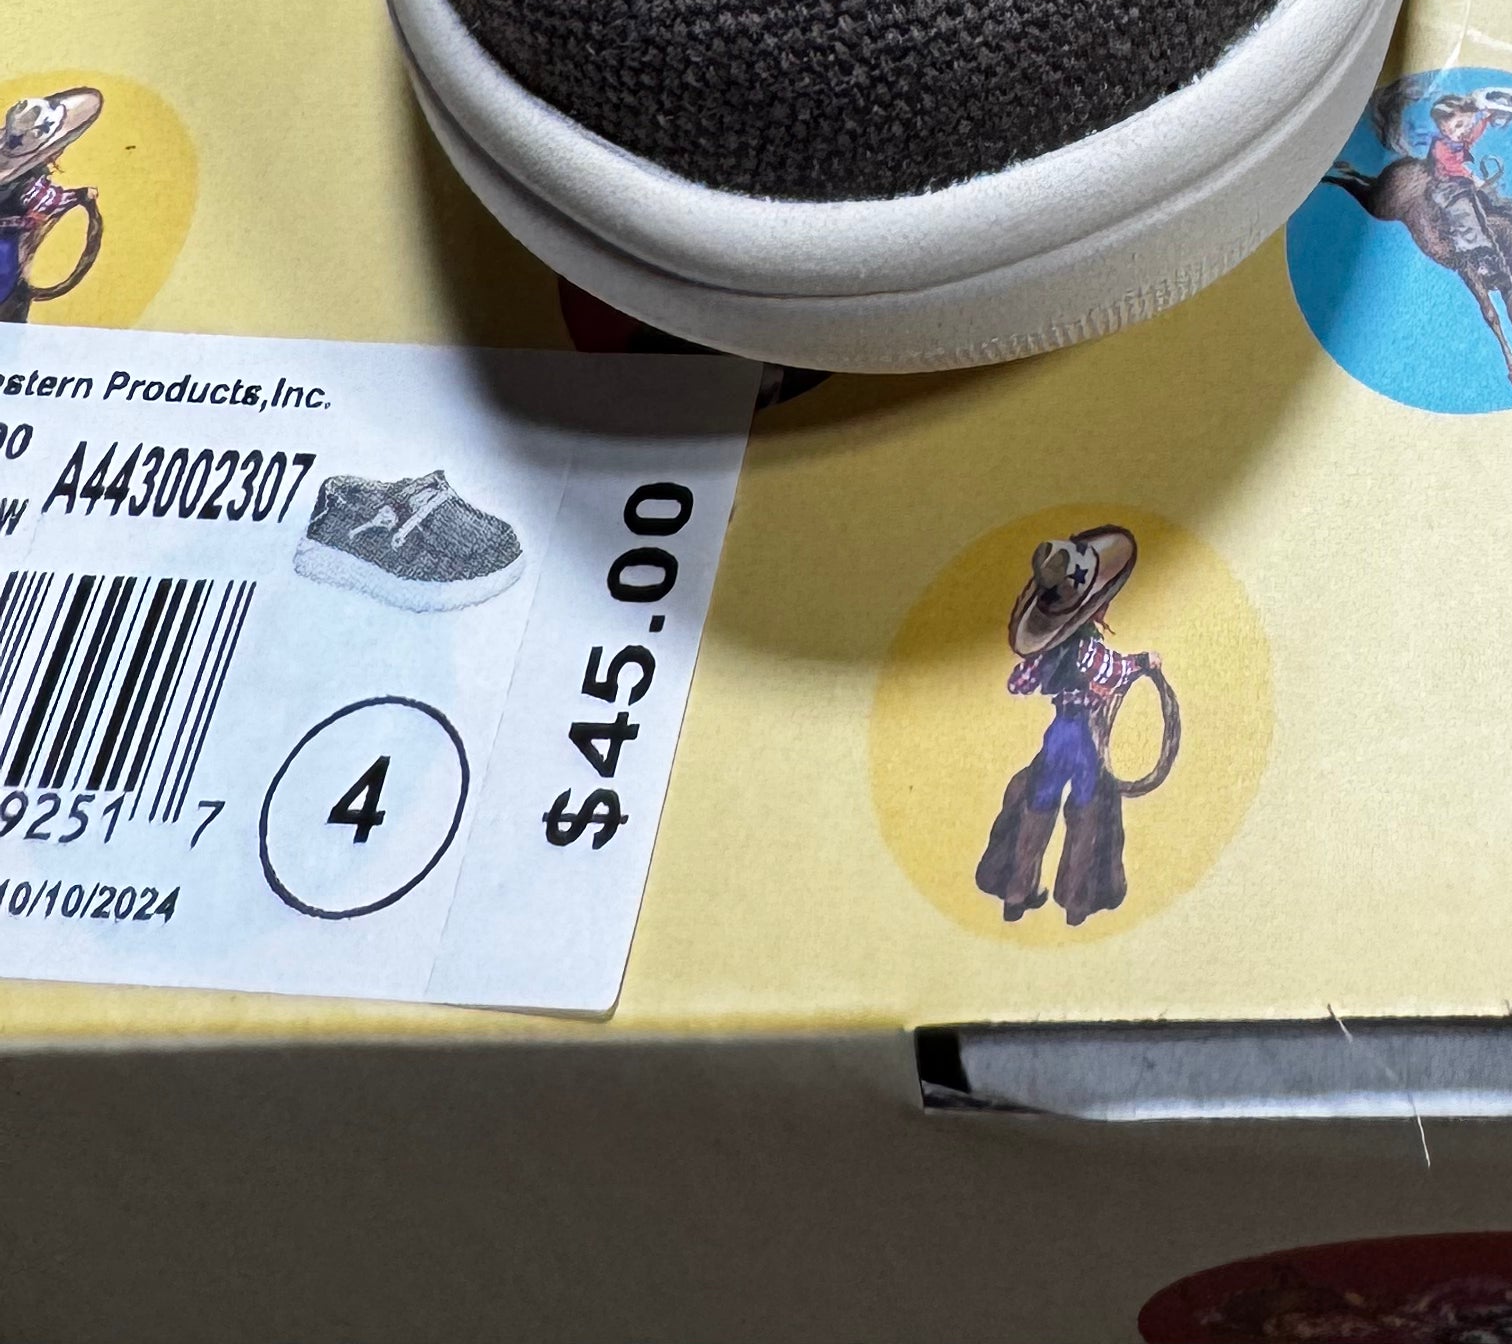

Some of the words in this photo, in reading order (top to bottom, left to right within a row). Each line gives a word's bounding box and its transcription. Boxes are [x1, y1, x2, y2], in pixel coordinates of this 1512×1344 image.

[103, 370, 331, 412] Products,Inc.
[41, 441, 317, 523] A443002307
[542, 482, 694, 850] $45.00
[0, 790, 125, 843] 9251
[190, 800, 225, 848] 7
[328, 755, 391, 844] 4
[0, 878, 180, 925] 10/10/2024
